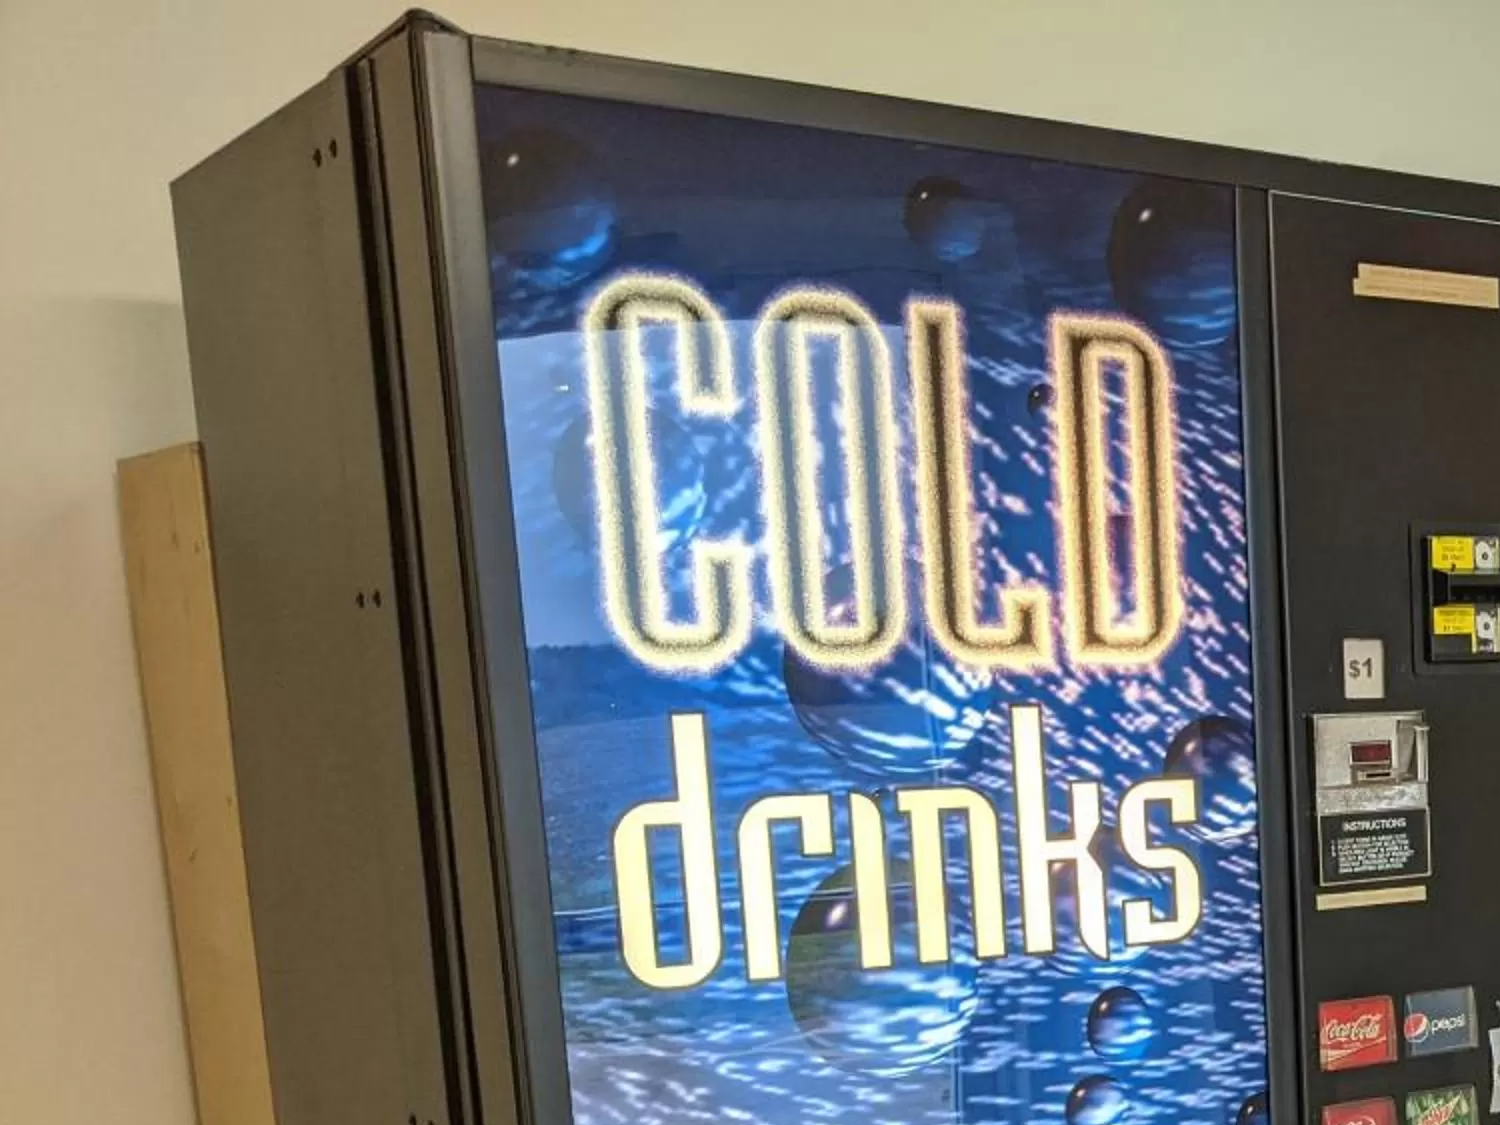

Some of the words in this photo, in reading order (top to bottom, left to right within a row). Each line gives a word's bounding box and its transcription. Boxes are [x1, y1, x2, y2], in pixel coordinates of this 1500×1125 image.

[582, 266, 1187, 676] COLD
[1348, 657, 1374, 680] $1
[1342, 817, 1407, 832] INSTRUCTIONS
[611, 703, 1201, 990] drinks
[1431, 1013, 1466, 1036] pepsi
